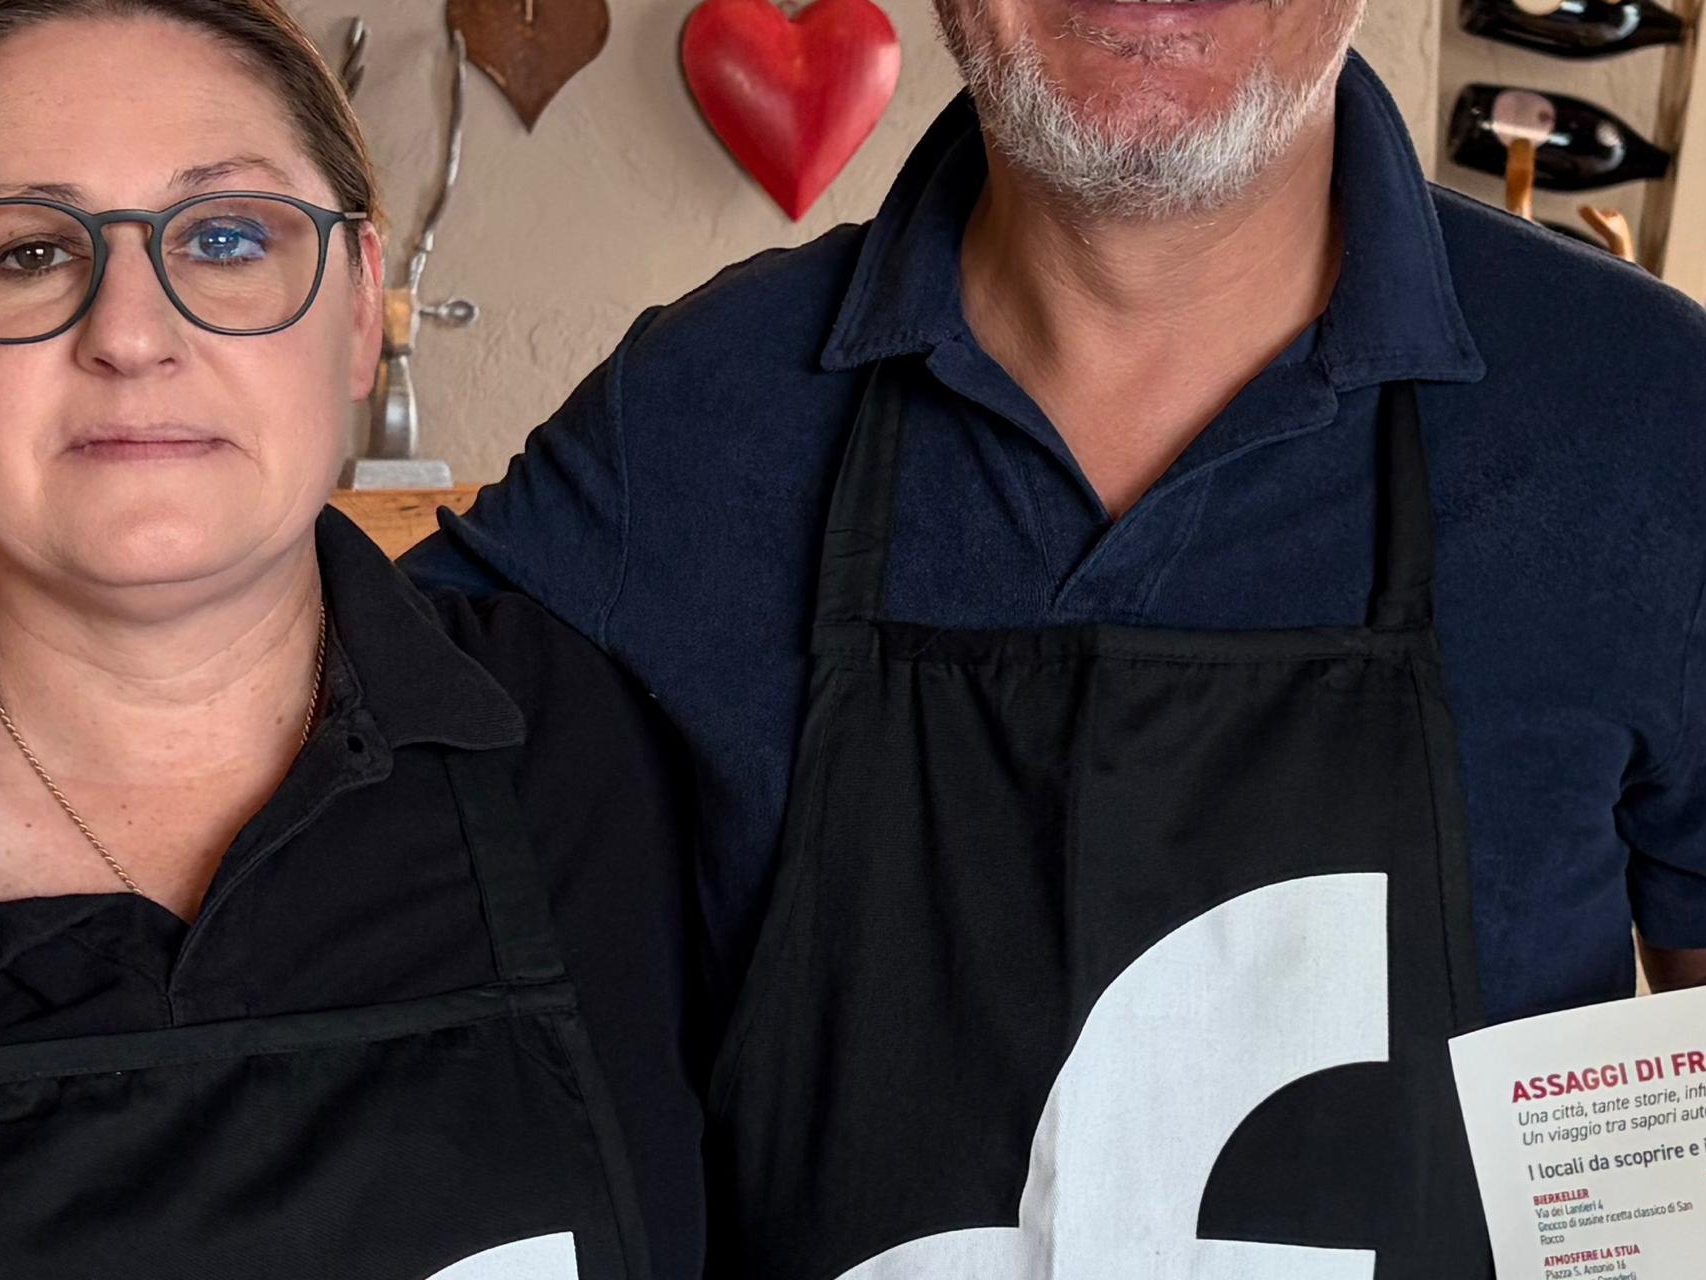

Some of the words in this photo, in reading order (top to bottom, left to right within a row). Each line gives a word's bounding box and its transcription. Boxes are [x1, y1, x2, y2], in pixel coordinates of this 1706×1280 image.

[1512, 1064, 1628, 1102] ASSAGGI
[1635, 1057, 1664, 1082] DI
[1518, 1112, 1548, 1126] Una
[1552, 1103, 1588, 1120] città,
[1592, 1099, 1630, 1114] tante
[1634, 1090, 1680, 1108] storie,
[1522, 1132, 1544, 1146] Un
[1548, 1122, 1601, 1142] viaggio
[1605, 1120, 1626, 1133] tra
[1630, 1109, 1676, 1130] sapori
[1528, 1165, 1534, 1181] I
[1538, 1158, 1584, 1178] locali
[1588, 1155, 1610, 1171] da
[1614, 1145, 1684, 1167] scoprire
[1689, 1144, 1699, 1156] e
[1534, 1189, 1589, 1205] BIERKELLER
[1545, 1251, 1599, 1266] ATMOSFERE
[1601, 1249, 1613, 1259] LA
[1615, 1245, 1640, 1257] STUA
